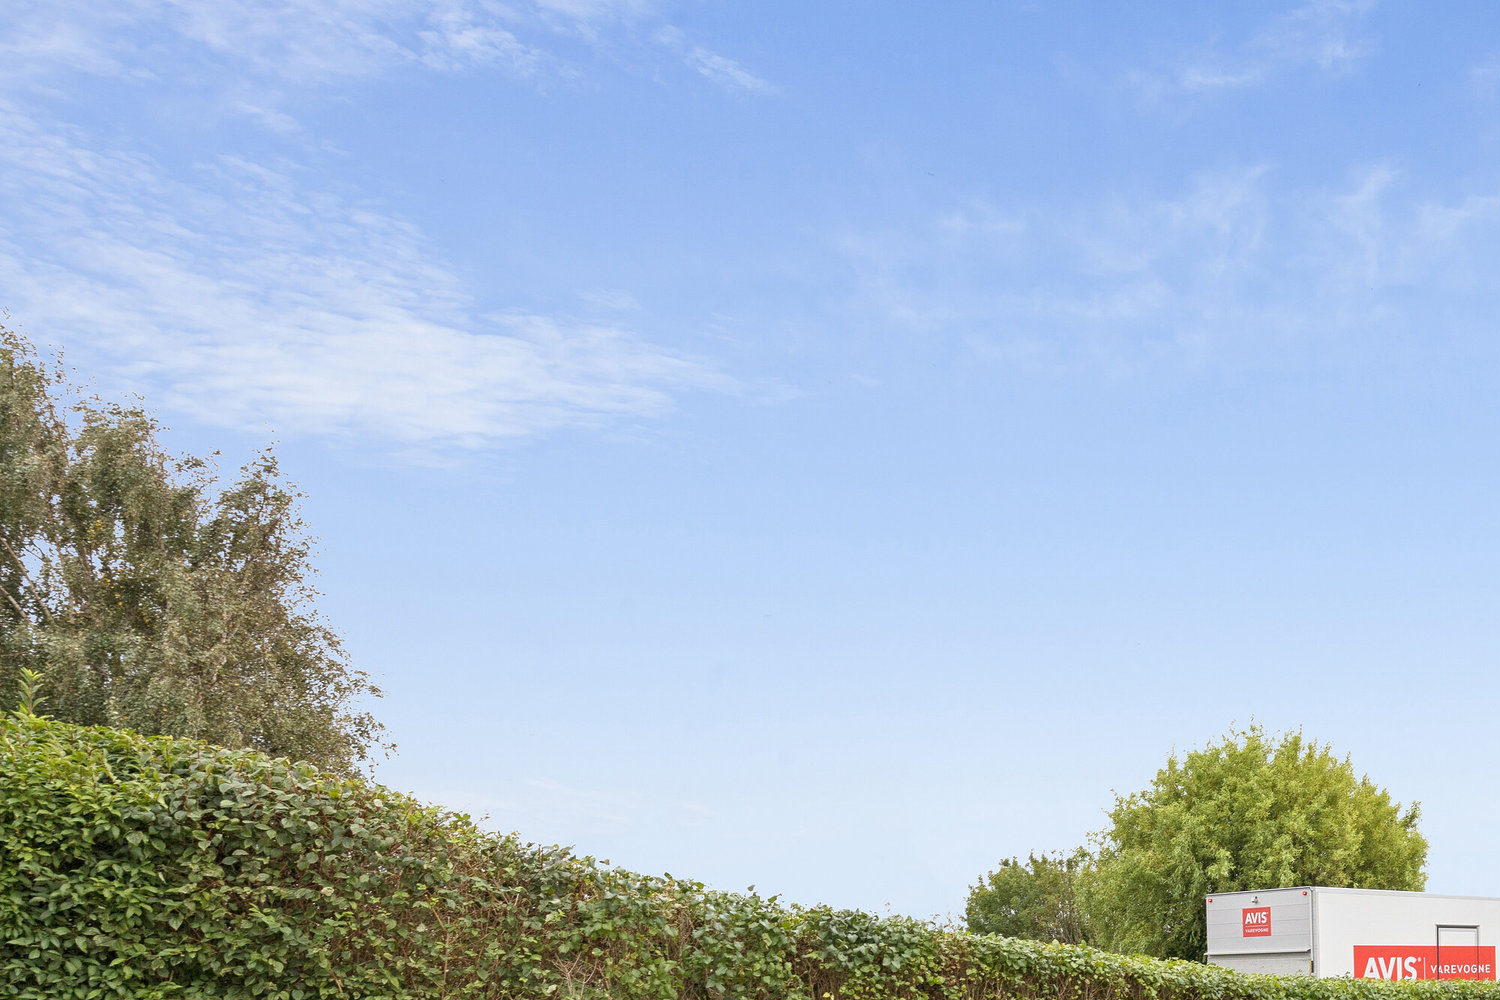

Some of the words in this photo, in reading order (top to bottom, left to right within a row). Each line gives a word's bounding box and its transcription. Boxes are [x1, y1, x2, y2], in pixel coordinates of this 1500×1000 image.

[1245, 911, 1267, 924] AVIS
[1363, 956, 1418, 980] AVIS
[1430, 964, 1491, 974] VAREVOGNE
